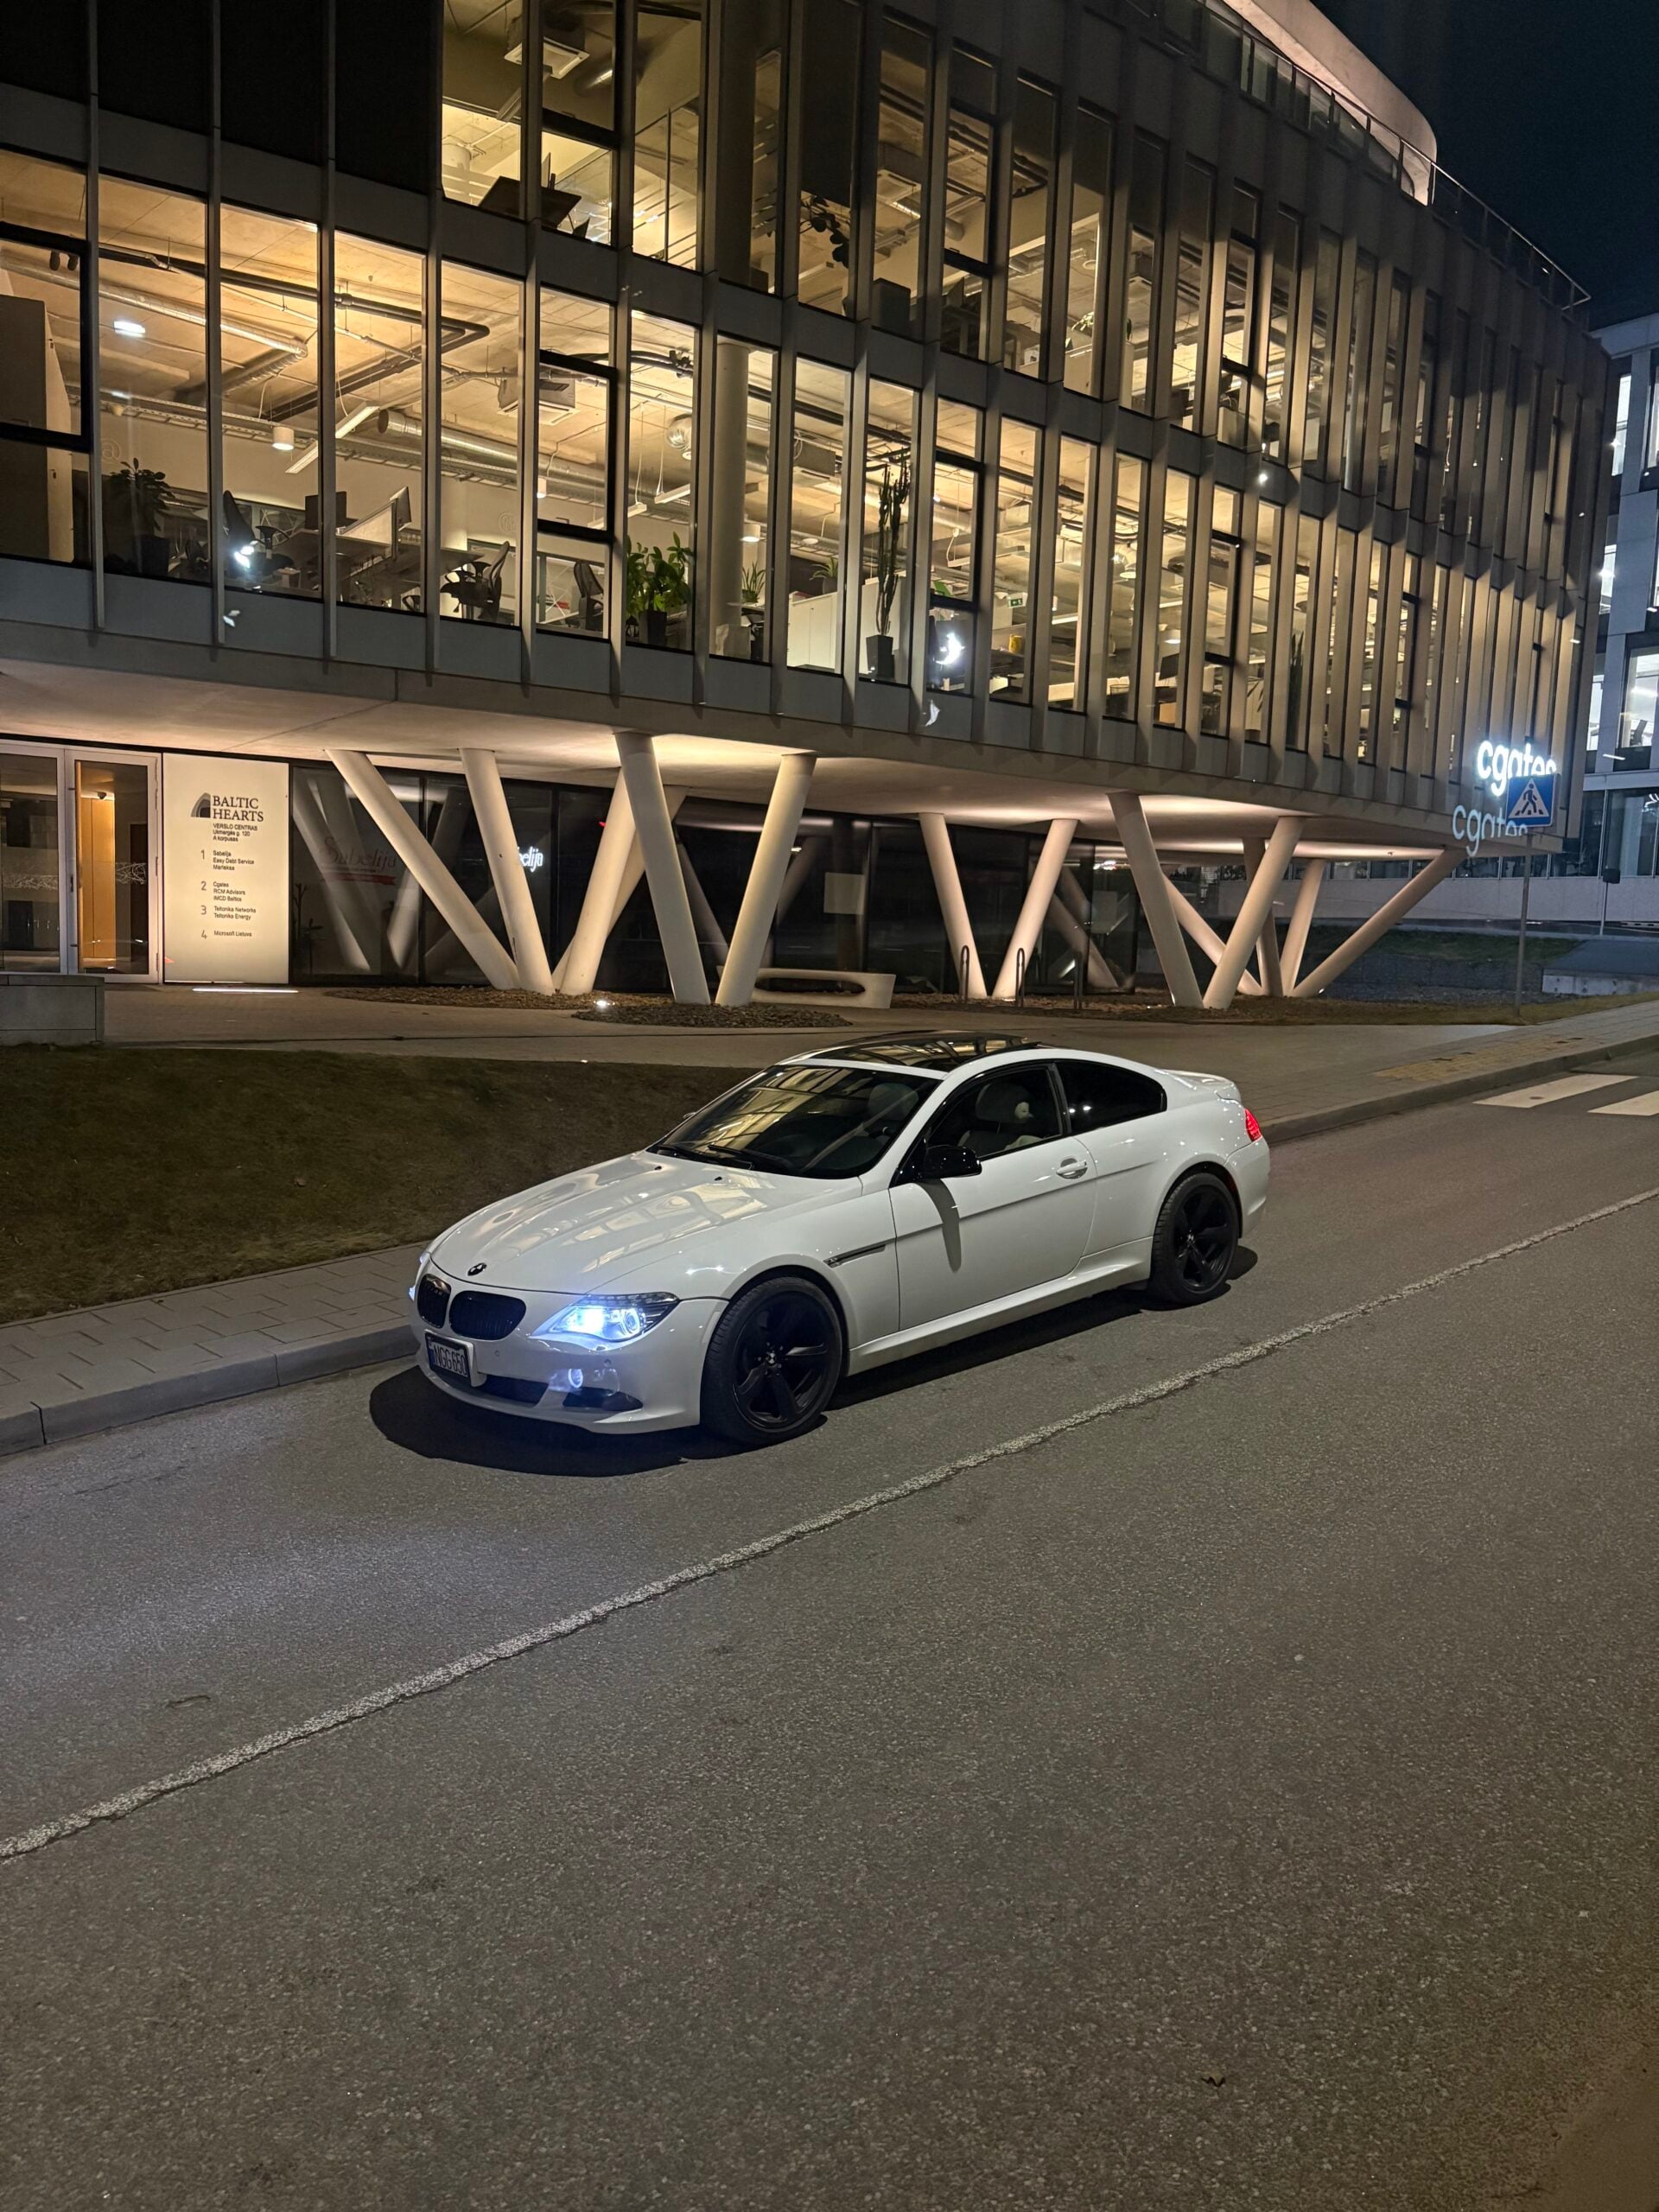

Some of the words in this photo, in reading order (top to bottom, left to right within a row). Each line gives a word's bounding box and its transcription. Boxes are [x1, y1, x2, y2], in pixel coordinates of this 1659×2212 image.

[213, 795, 258, 810] BALTIC
[213, 809, 264, 823] HEARTS
[200, 849, 205, 860] 1
[200, 880, 207, 891] 2
[200, 905, 207, 915] 3
[200, 930, 207, 939] 4
